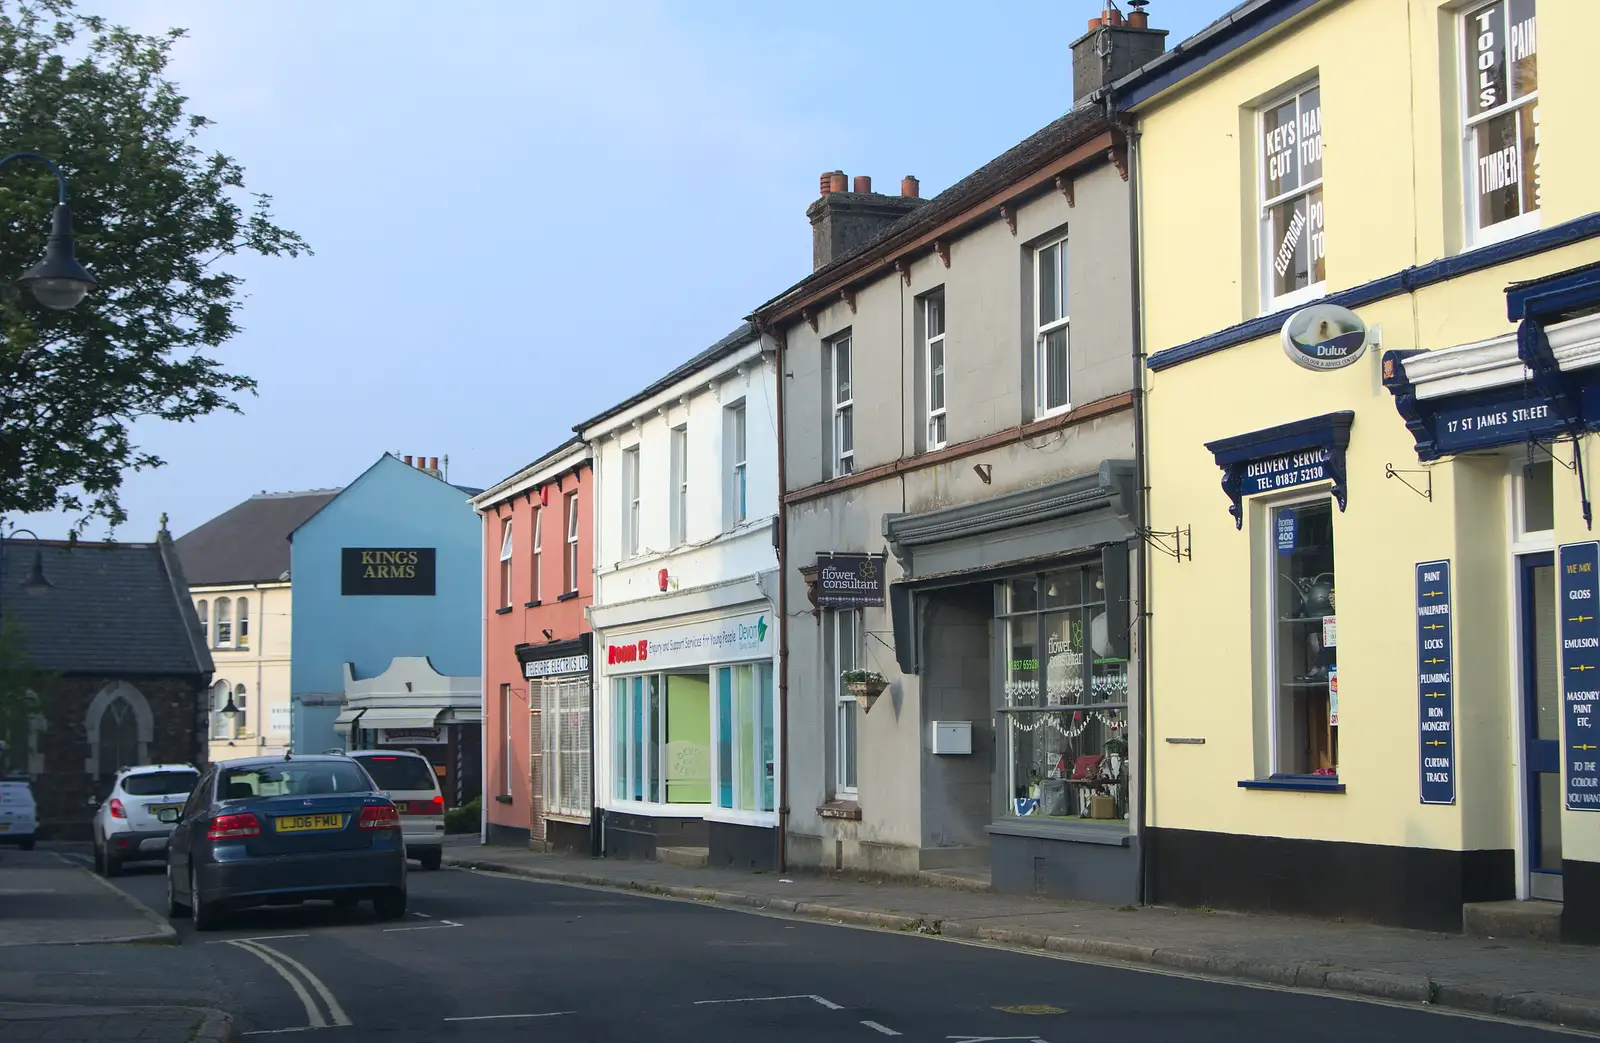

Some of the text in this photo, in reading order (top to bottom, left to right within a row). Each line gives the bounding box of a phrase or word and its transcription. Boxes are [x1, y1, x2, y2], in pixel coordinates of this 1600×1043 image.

[1475, 8, 1496, 108] TOOLS
[1266, 120, 1296, 157] KEYS
[1269, 148, 1292, 181] CUT
[1479, 145, 1518, 195] TIMBER
[1274, 208, 1306, 278] ELECTRICAL
[1317, 345, 1347, 356] Dulux
[1301, 355, 1320, 366] COLOUR
[1447, 405, 1548, 433] 17 ST JAMES STREET
[1247, 456, 1290, 477] DELIVERY
[1257, 466, 1324, 490] TEL: 01837 52130
[1278, 532, 1294, 541] 400
[361, 551, 418, 565] KINGS
[363, 565, 416, 578] ARMS
[822, 568, 856, 580] flower
[1567, 562, 1593, 574] WE MIX
[1424, 571, 1441, 582] PAINT
[823, 578, 878, 590] consultant
[1569, 589, 1591, 600] GLOSS
[1418, 604, 1449, 616] WALLPAPER
[739, 623, 757, 640] Devon
[608, 644, 637, 665] Room
[684, 636, 702, 649] Services
[710, 633, 722, 648] Young
[722, 630, 736, 646] People
[1048, 638, 1072, 654] flower
[1424, 639, 1443, 650] LOCKS
[1564, 638, 1599, 649] EMULSION
[527, 656, 588, 676] TELECARE ELECTRICS LTD
[1420, 673, 1449, 684] PLUMBING
[1567, 691, 1600, 701] MASONRY
[1428, 707, 1443, 717] IRON
[1573, 704, 1592, 714] PAINT
[1421, 722, 1450, 732] MONGERY
[1424, 757, 1449, 768] CURTAIN
[1573, 761, 1596, 772] TO THE
[1426, 772, 1448, 782] TRACKS
[1571, 777, 1598, 787] COLOUR
[1568, 793, 1582, 803] YOU
